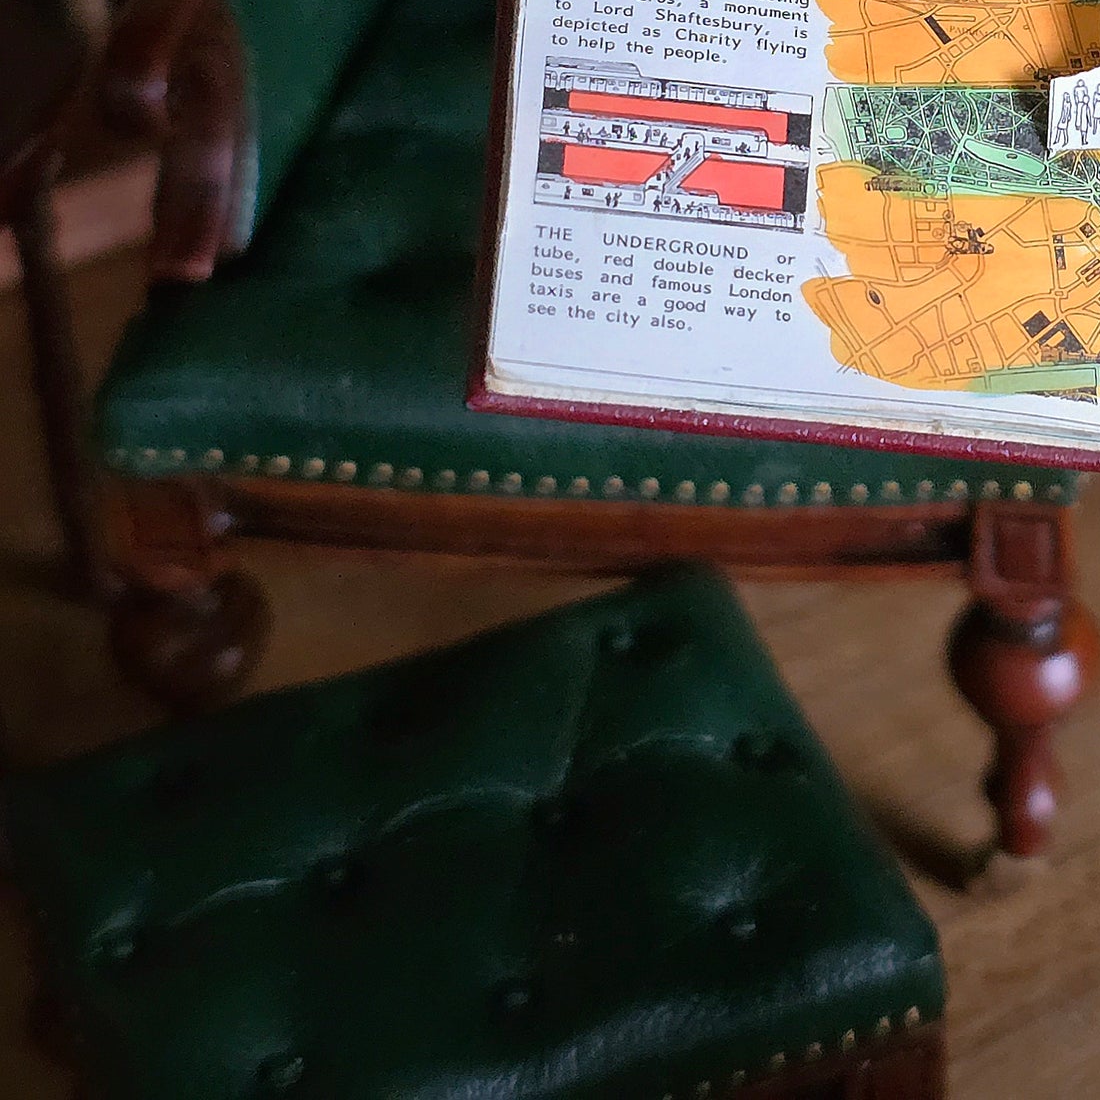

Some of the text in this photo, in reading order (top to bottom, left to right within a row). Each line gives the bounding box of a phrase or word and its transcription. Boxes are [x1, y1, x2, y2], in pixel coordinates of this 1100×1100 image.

[594, 2, 634, 17] Lord
[655, 9, 771, 36] Shaftesbury,
[794, 27, 808, 39] is
[700, 0, 709, 9] a
[724, 2, 809, 23] monument
[552, 16, 807, 58] depicted as Charity flying
[552, 33, 727, 64] to help the people.
[534, 244, 795, 284] tube, red double decker
[535, 225, 796, 265] THE UNDERGROUND or
[529, 282, 791, 322] taxis are a good way to
[531, 263, 792, 302] buses and famous London
[527, 303, 693, 331] see the city also.
